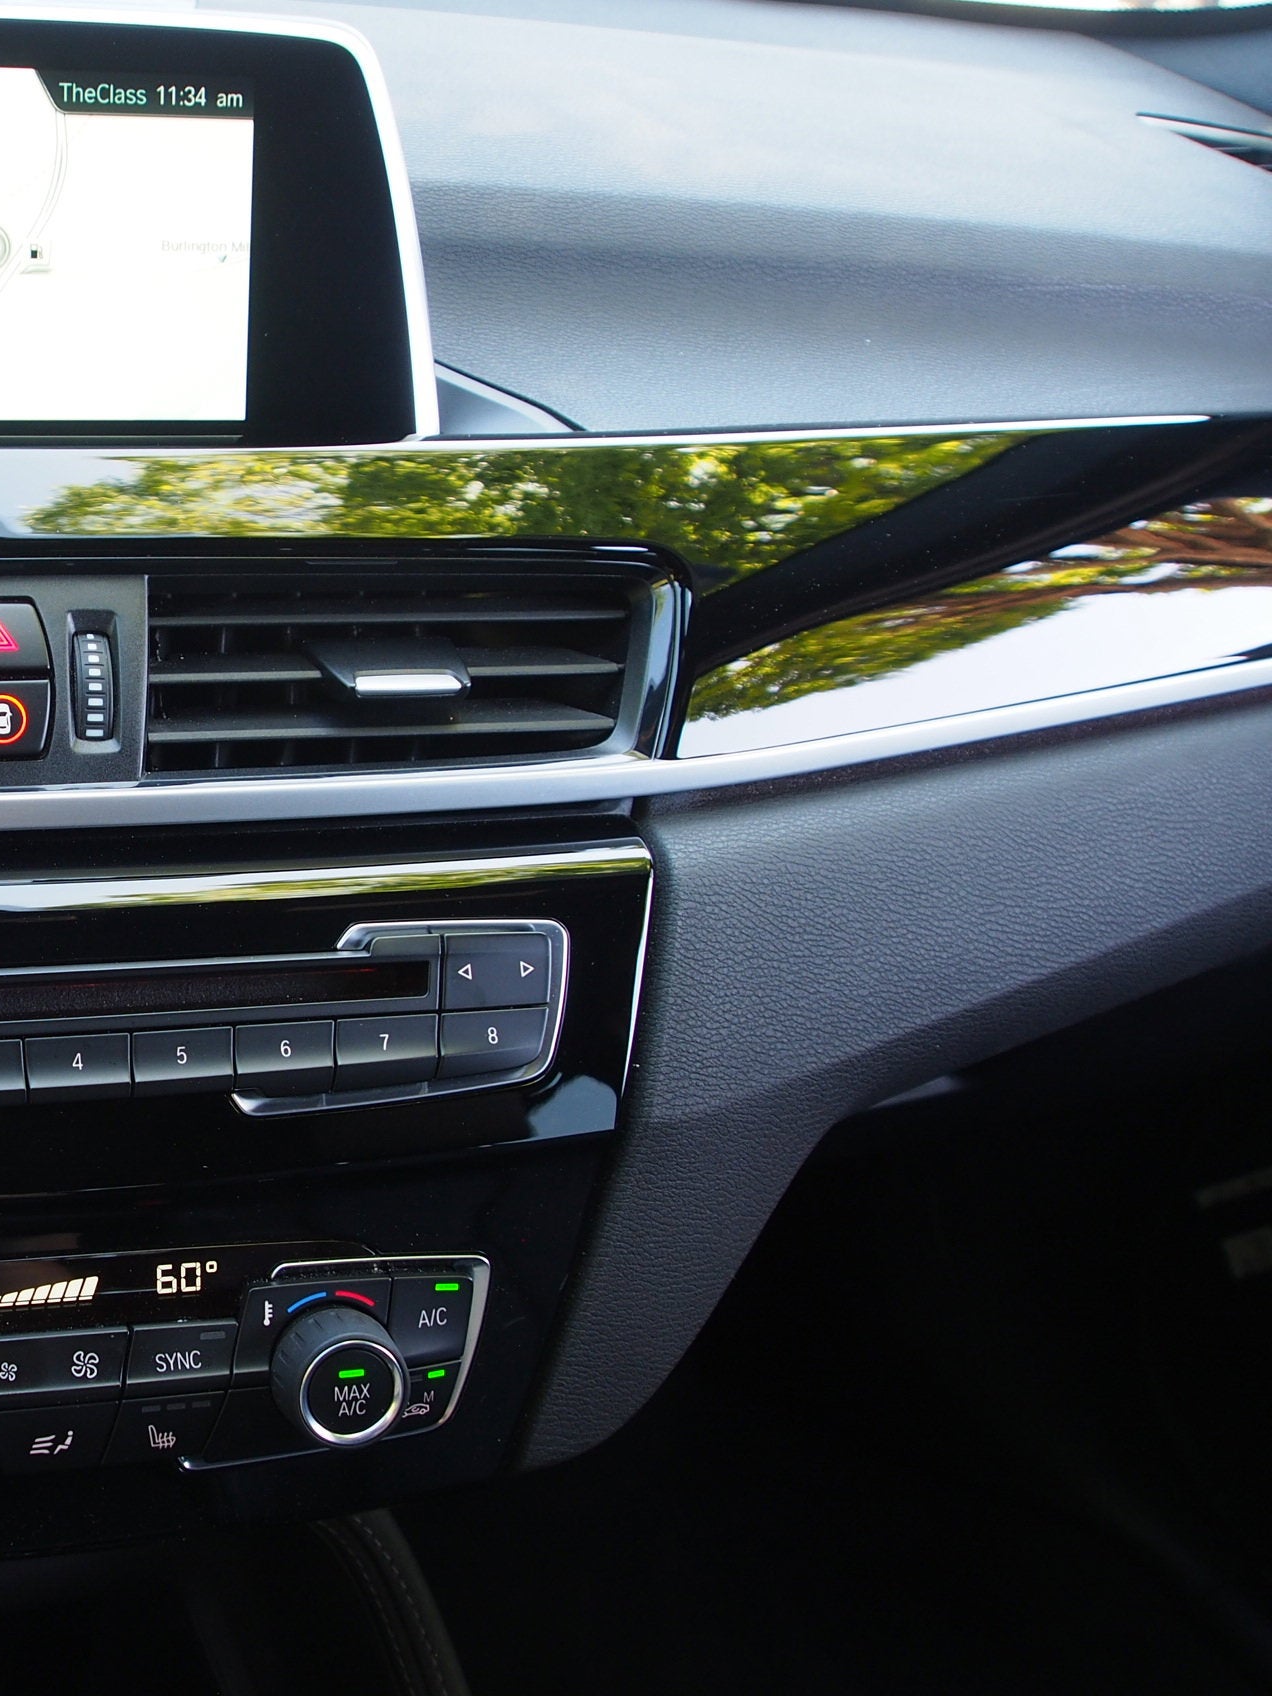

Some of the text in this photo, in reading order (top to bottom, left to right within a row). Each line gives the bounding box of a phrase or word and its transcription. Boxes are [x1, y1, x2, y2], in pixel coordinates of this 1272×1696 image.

[58, 83, 244, 108] TheClass 11:34 am
[160, 240, 227, 254] Burlington
[379, 1033, 390, 1052] 7
[487, 1026, 499, 1045] 8
[176, 1046, 187, 1065] 5
[280, 1040, 291, 1059] 6
[72, 1052, 84, 1071] 4
[418, 1307, 448, 1329] A/C
[155, 1350, 203, 1373] SYNC
[334, 1383, 371, 1403] MAX
[423, 1390, 434, 1403] M
[338, 1399, 367, 1417] A/C
